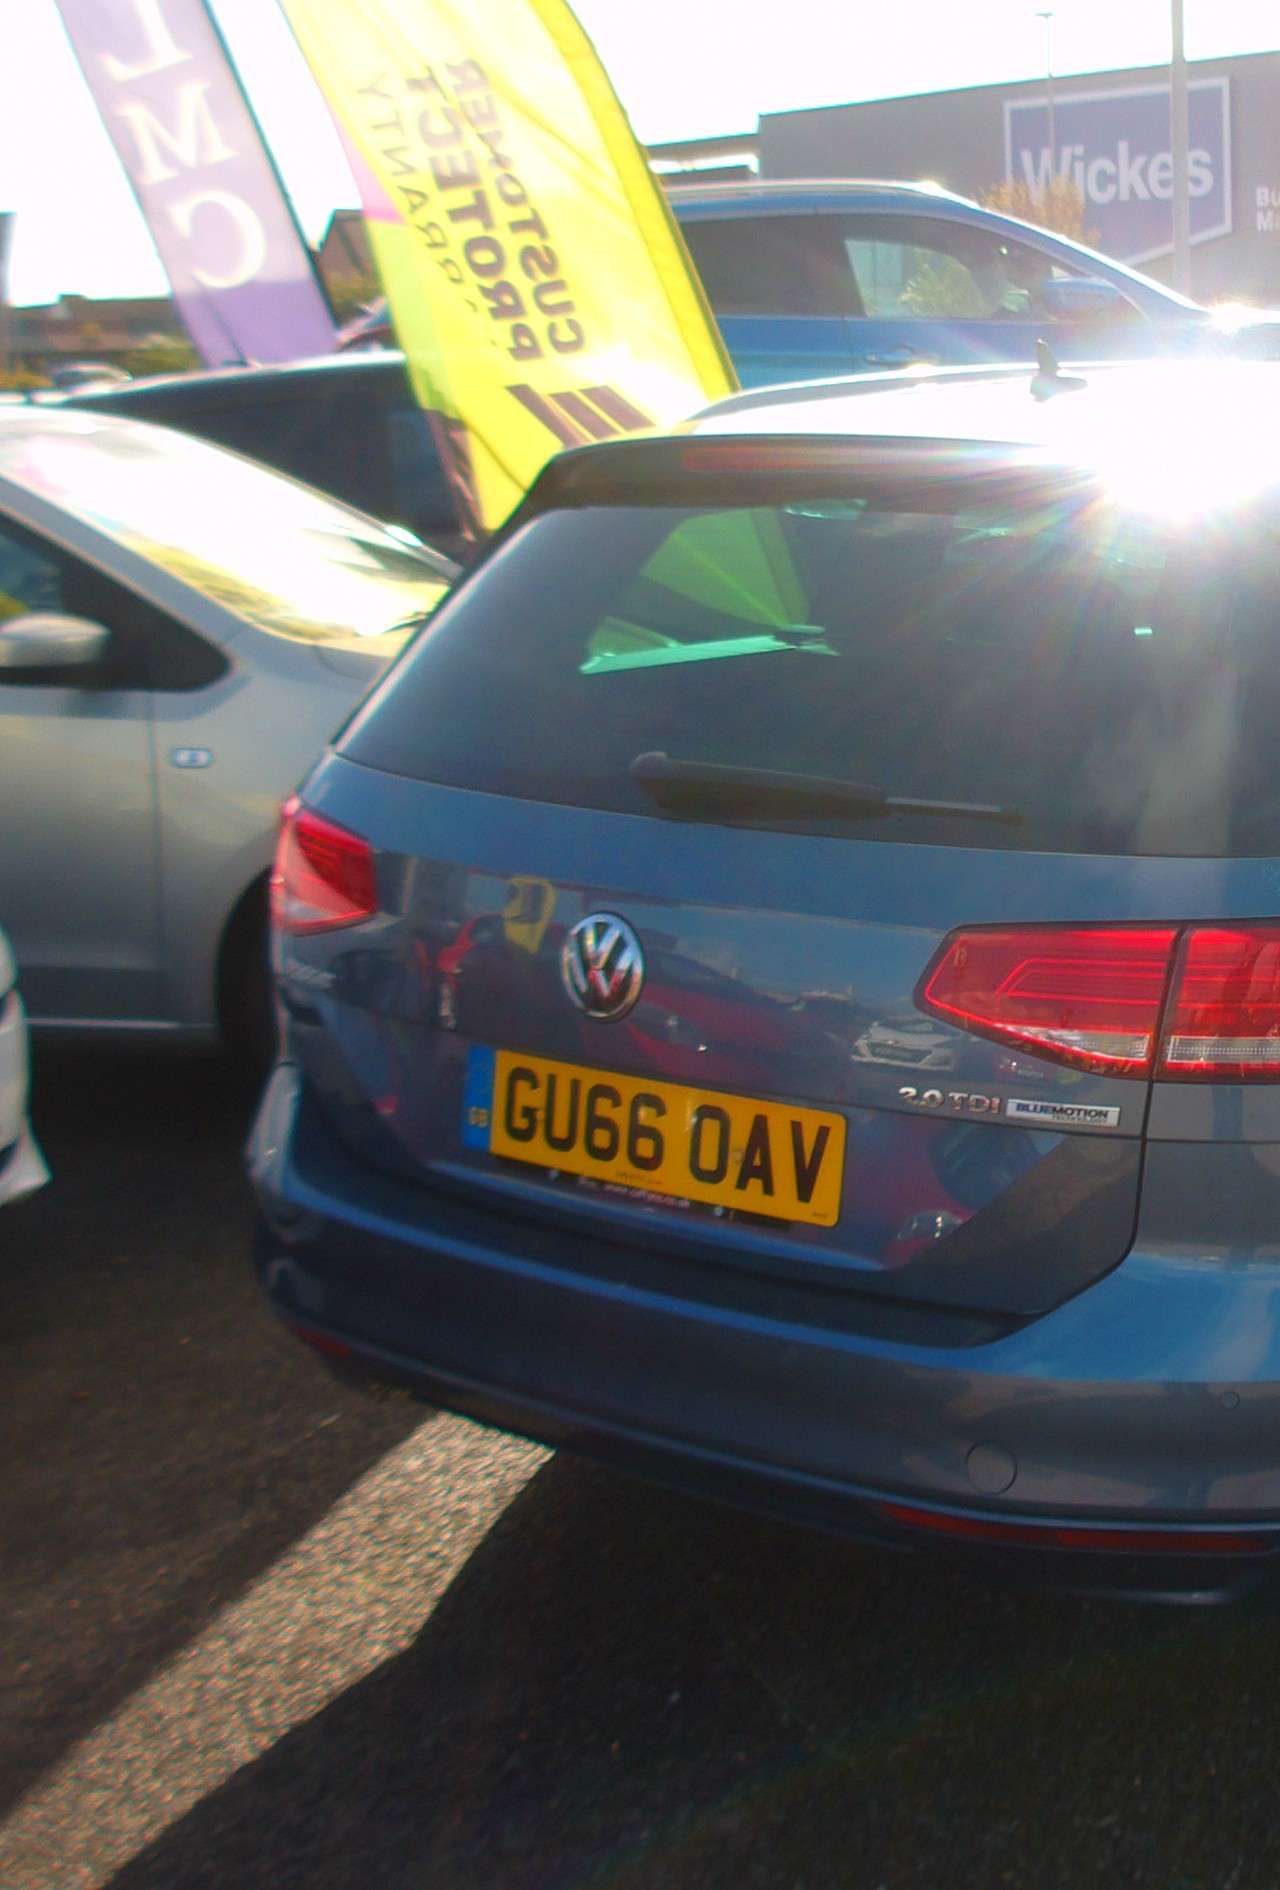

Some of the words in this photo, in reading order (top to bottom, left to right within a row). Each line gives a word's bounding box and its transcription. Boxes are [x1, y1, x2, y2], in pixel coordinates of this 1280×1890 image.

[1020, 139, 1215, 206] Wickes
[948, 1091, 1001, 1115] TDI
[1016, 1103, 1109, 1119] BLUEMOTION
[503, 1066, 668, 1172] GU66
[688, 1104, 832, 1204] OAV
